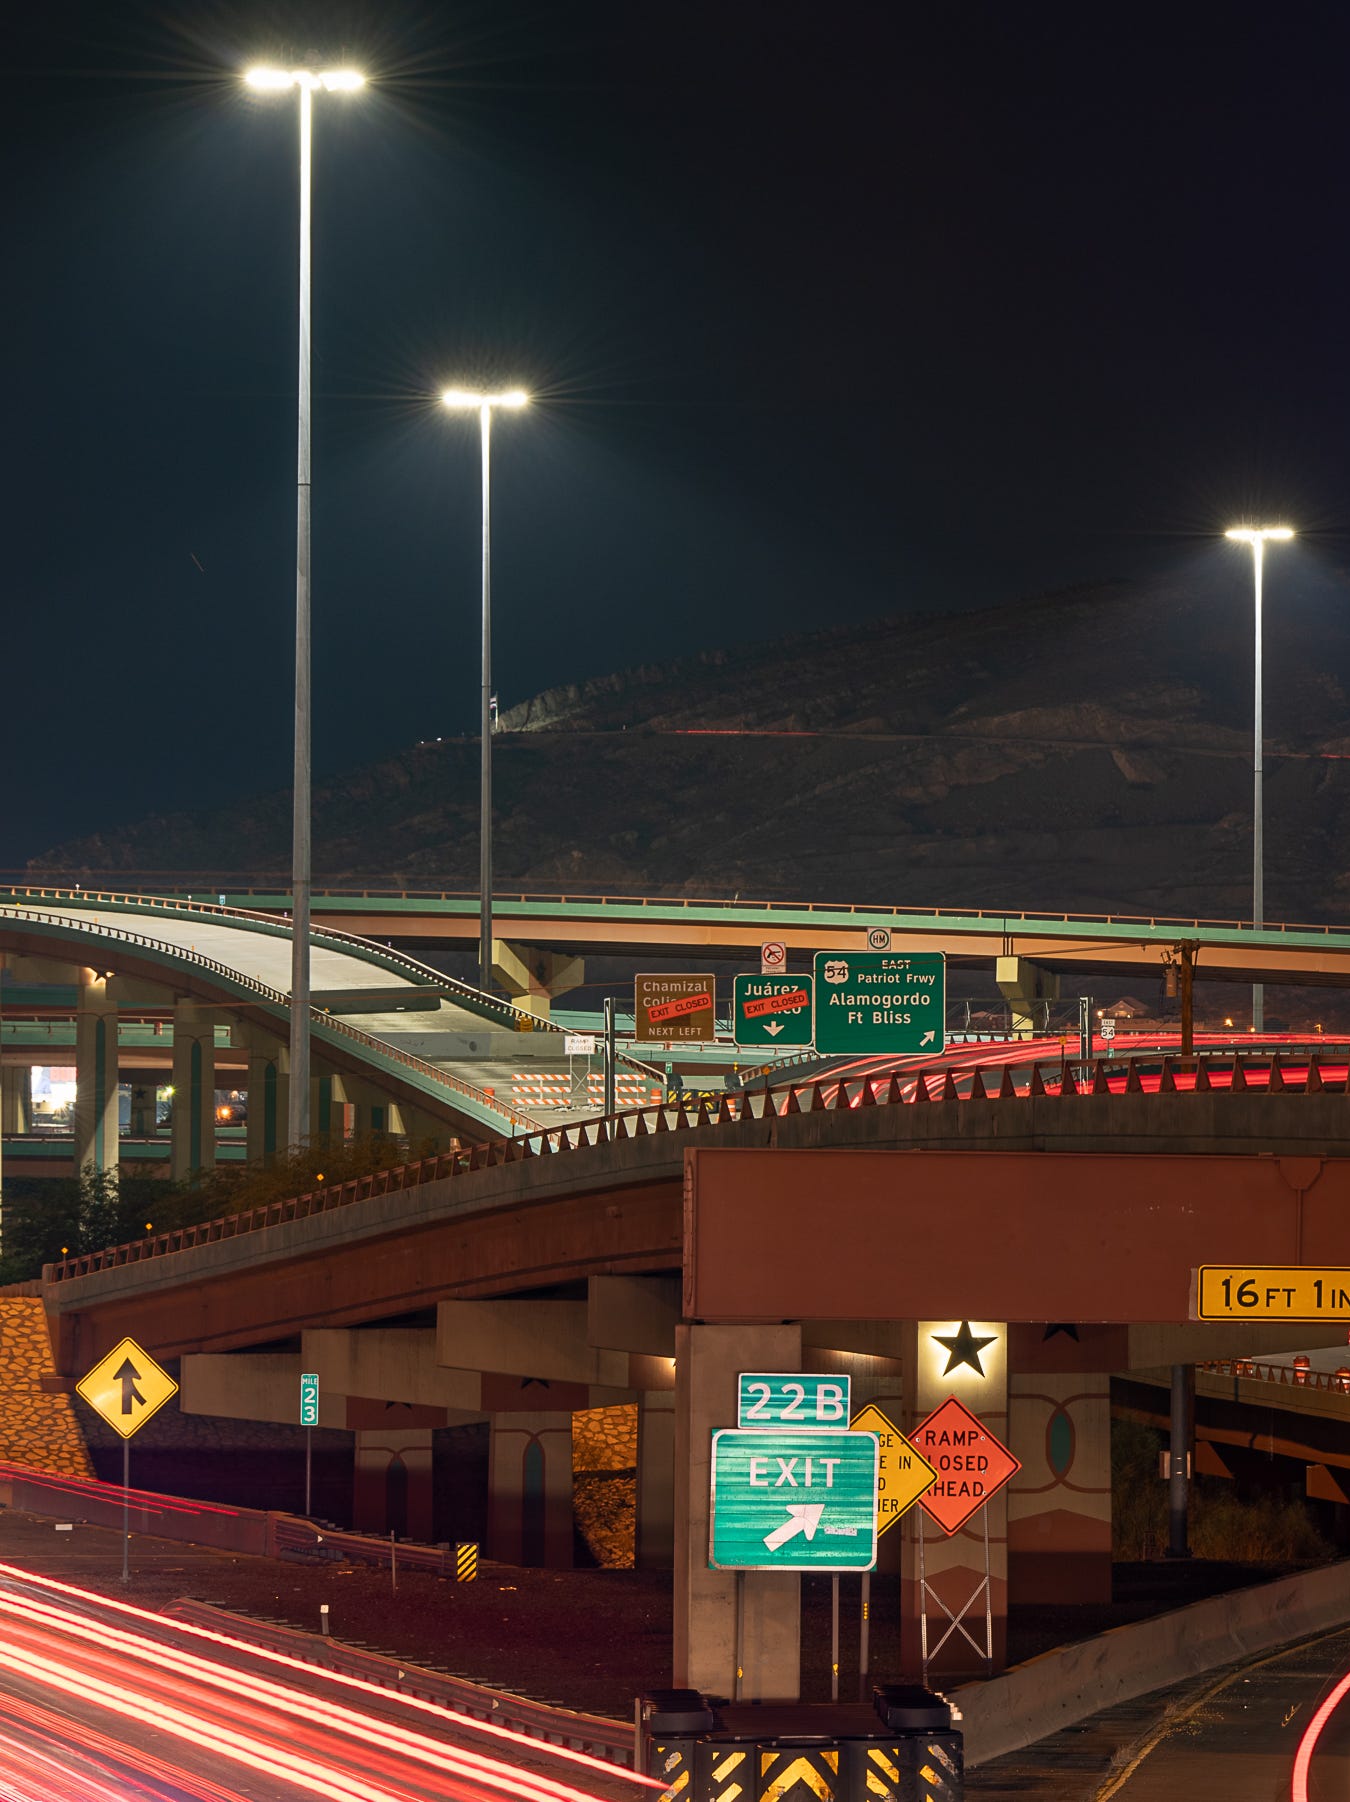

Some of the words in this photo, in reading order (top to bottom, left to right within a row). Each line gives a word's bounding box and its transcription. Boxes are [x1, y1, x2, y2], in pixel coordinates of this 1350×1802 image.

[873, 934, 886, 944] HM
[882, 960, 911, 969] EAST
[826, 966, 847, 978] 54
[858, 973, 900, 983] Patriot
[906, 973, 936, 985] Frwy
[643, 980, 708, 992] Chamizal
[744, 982, 799, 996] Juárez
[746, 1003, 765, 1014] EXIT
[770, 994, 805, 1008] CLOSED
[829, 992, 931, 1009] Alamogordo
[650, 1007, 670, 1018] EXIT
[674, 997, 709, 1012] CLOSED
[848, 1012, 863, 1024] Ft
[872, 1011, 911, 1024] Bliss
[648, 1027, 673, 1036] NEXT
[679, 1027, 702, 1036] LEFT
[1102, 1029, 1114, 1037] 54
[302, 1377, 318, 1385] MILE
[746, 1383, 844, 1420] 22B
[925, 1430, 979, 1446] RAMP
[898, 1456, 912, 1469] IN
[929, 1455, 989, 1471] LOSED
[749, 1457, 841, 1487] EXIT
[926, 1481, 984, 1497] HEAD
